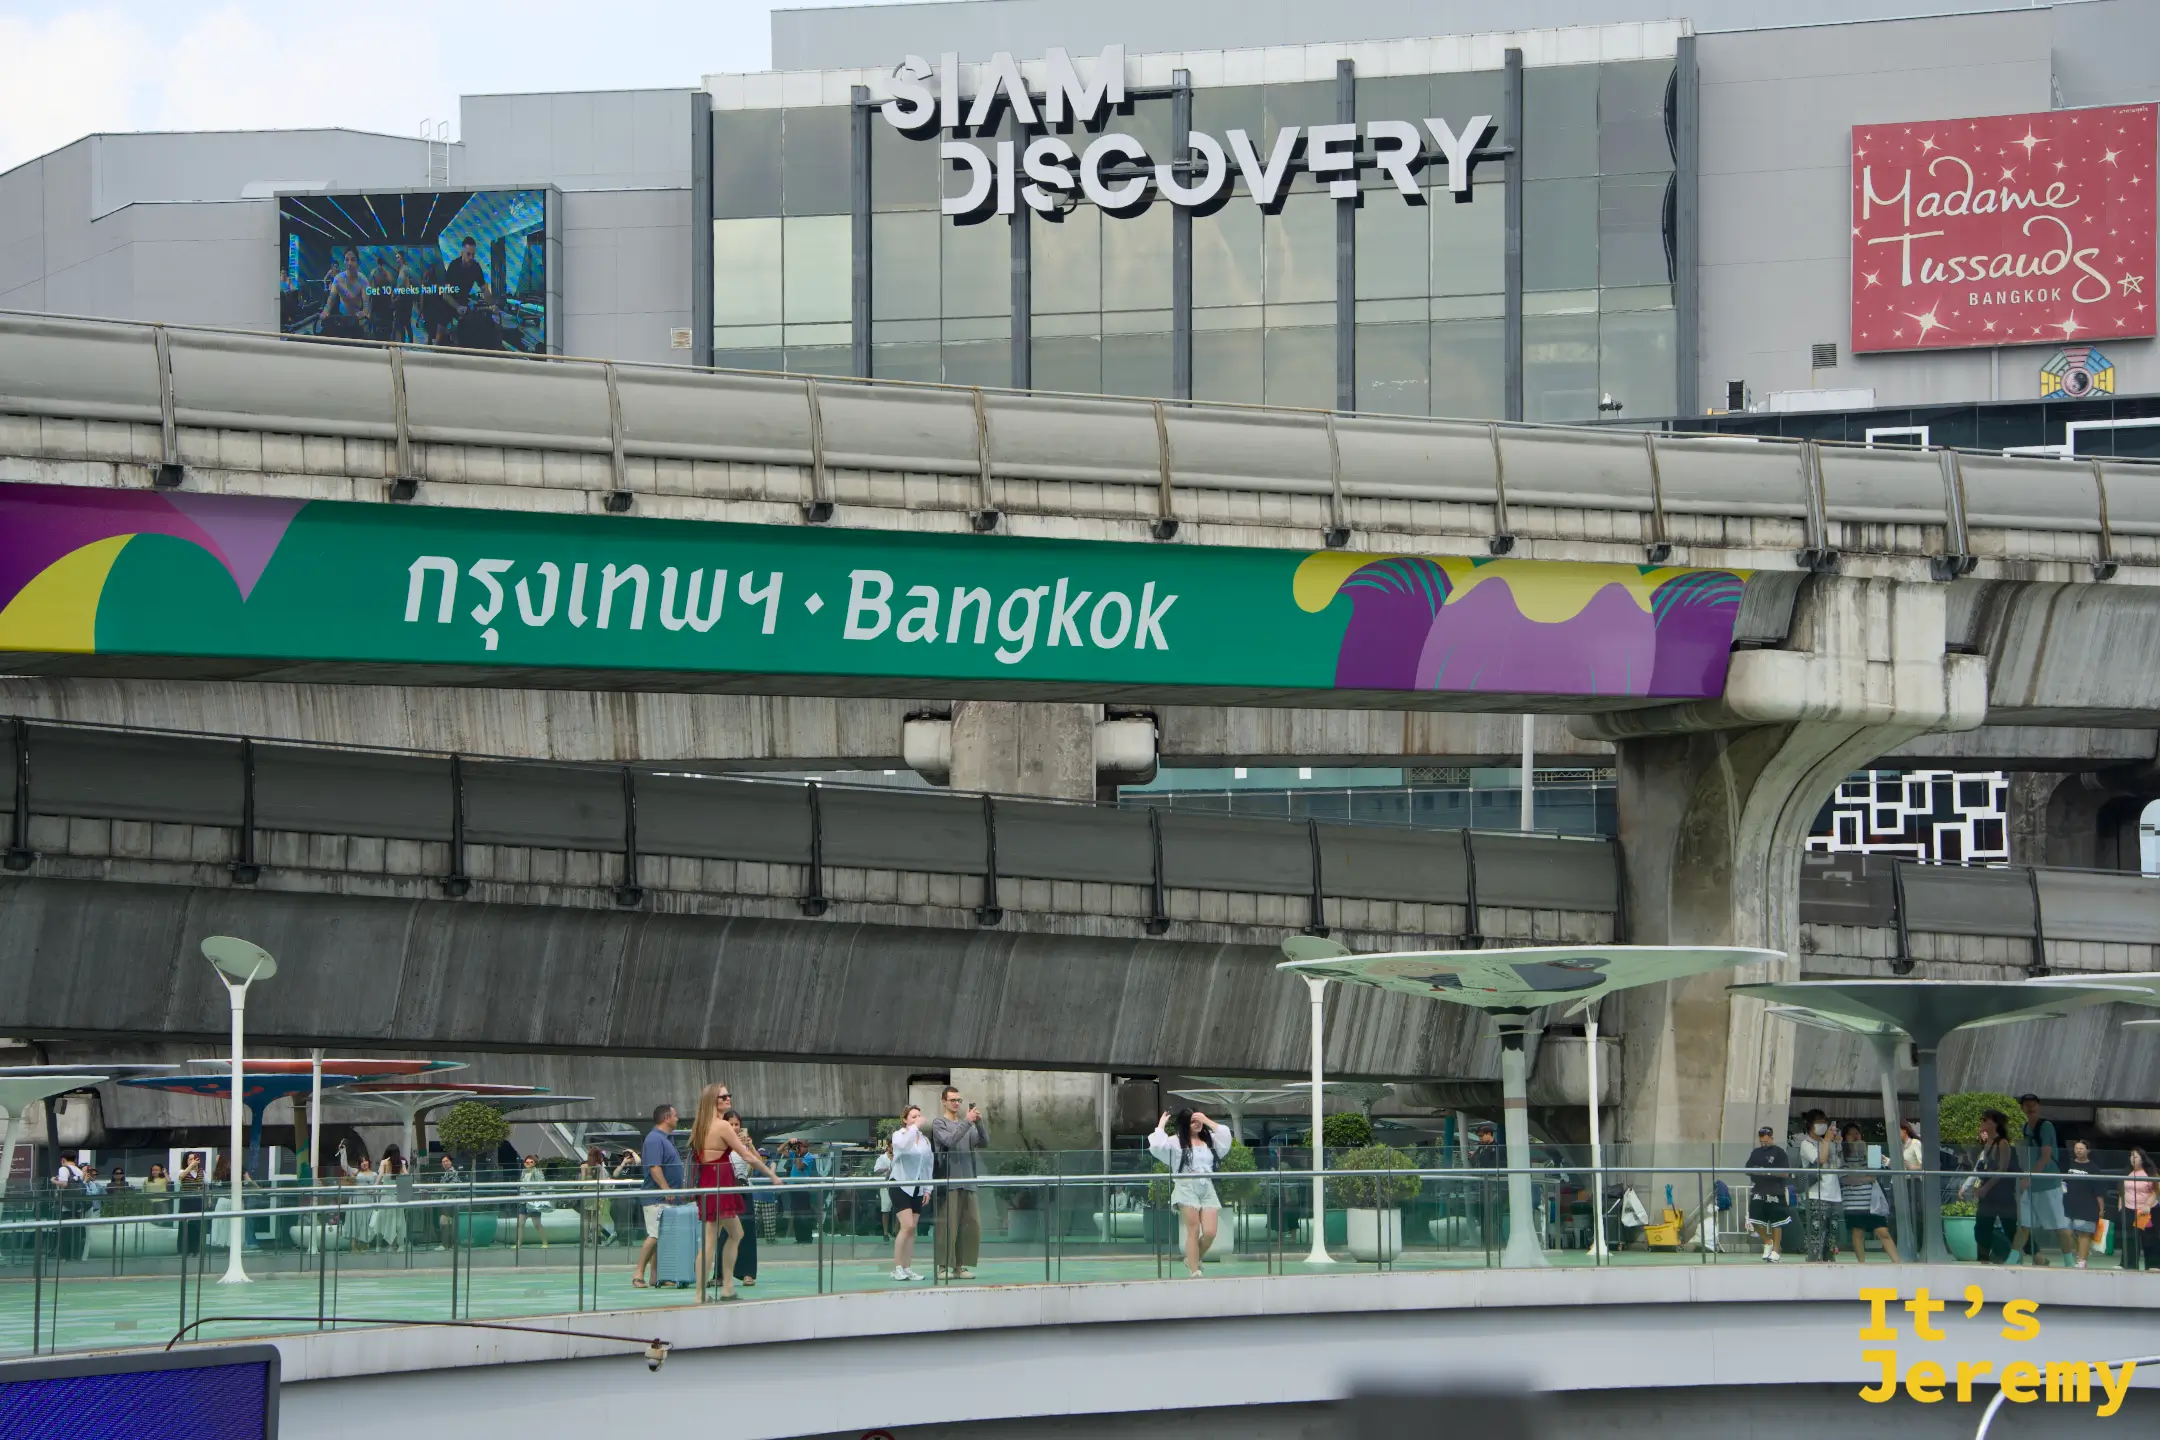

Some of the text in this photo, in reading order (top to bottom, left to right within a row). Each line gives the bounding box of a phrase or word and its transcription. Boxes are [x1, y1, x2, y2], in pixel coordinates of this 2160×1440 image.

[880, 43, 1126, 130] SIAM
[940, 114, 1493, 217] DISCOVERY
[1862, 156, 2080, 227] Madame
[365, 283, 461, 296] Get 10 weeks half price
[1867, 215, 2111, 304] Tussauds
[1968, 287, 2062, 306] BANGKOK
[403, 555, 1179, 665] กรุงเทพฯ Bangkok
